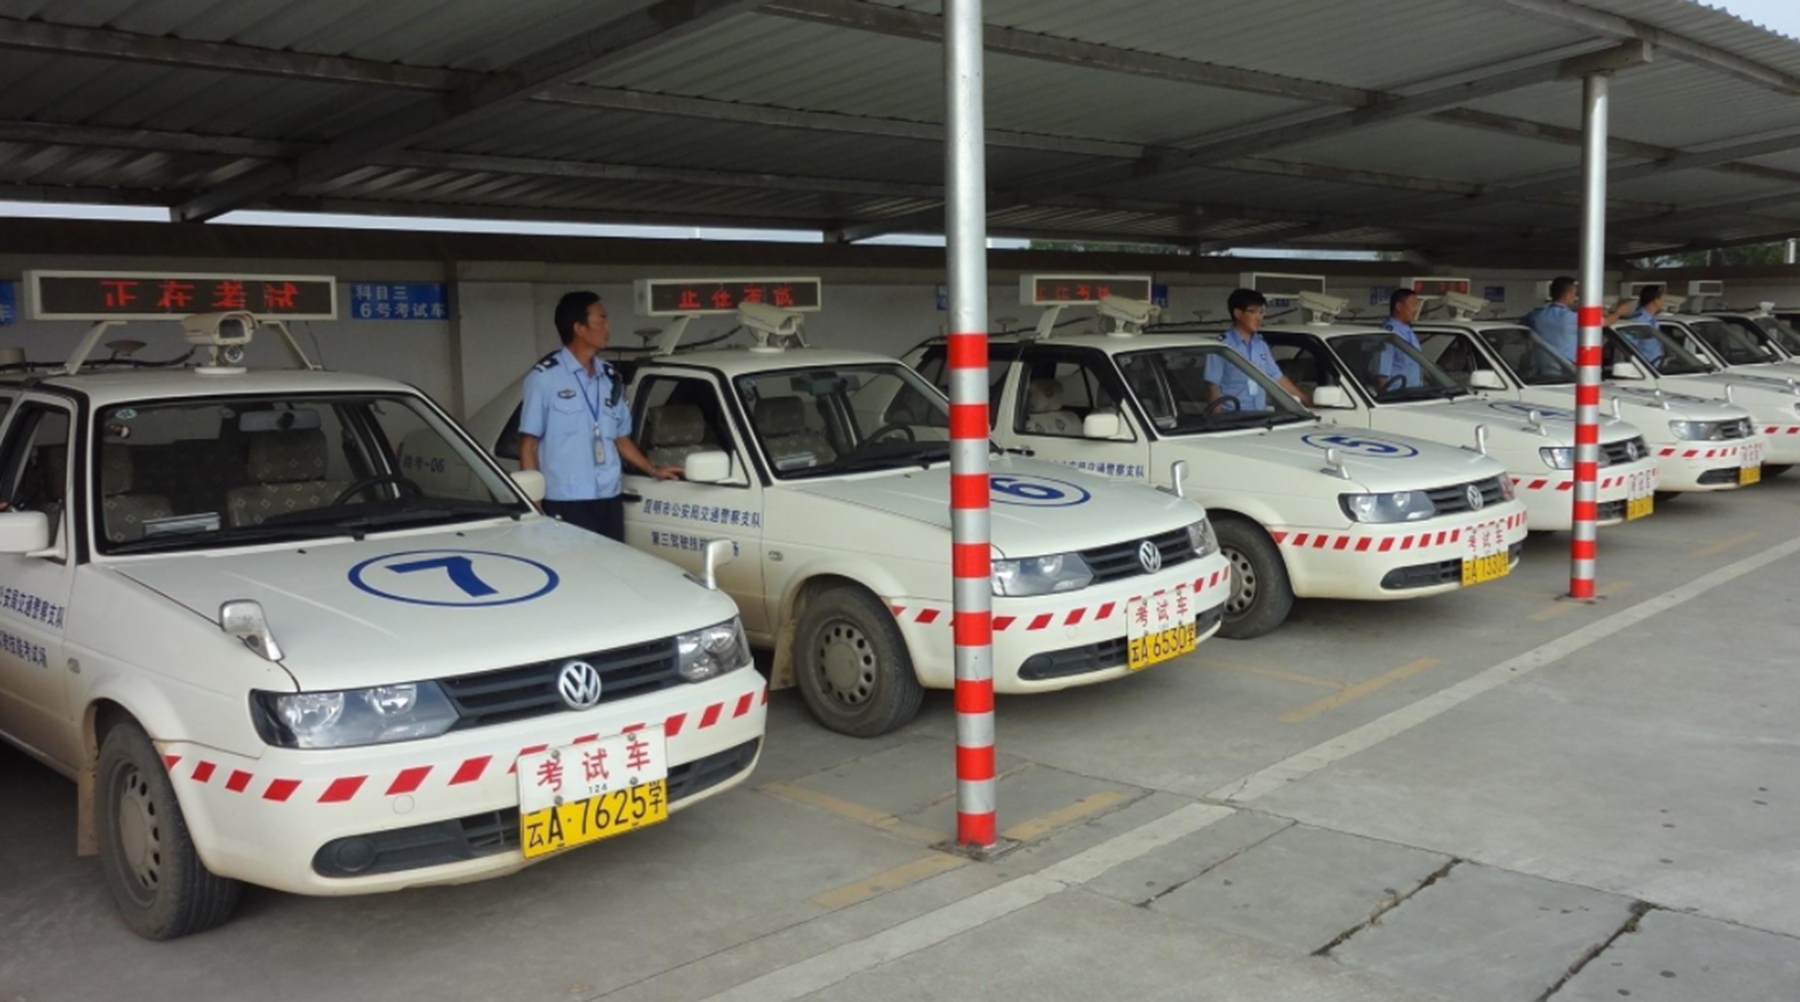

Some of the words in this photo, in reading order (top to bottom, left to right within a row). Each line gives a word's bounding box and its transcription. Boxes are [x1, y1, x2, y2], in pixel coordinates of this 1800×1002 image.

[356, 285, 408, 300] 科目三
[360, 302, 446, 318] 6号考试车
[1319, 436, 1399, 453] 5
[990, 477, 1065, 500] 6
[384, 555, 500, 598] 7
[1135, 596, 1188, 628] 考试车
[536, 740, 651, 793] 考试车
